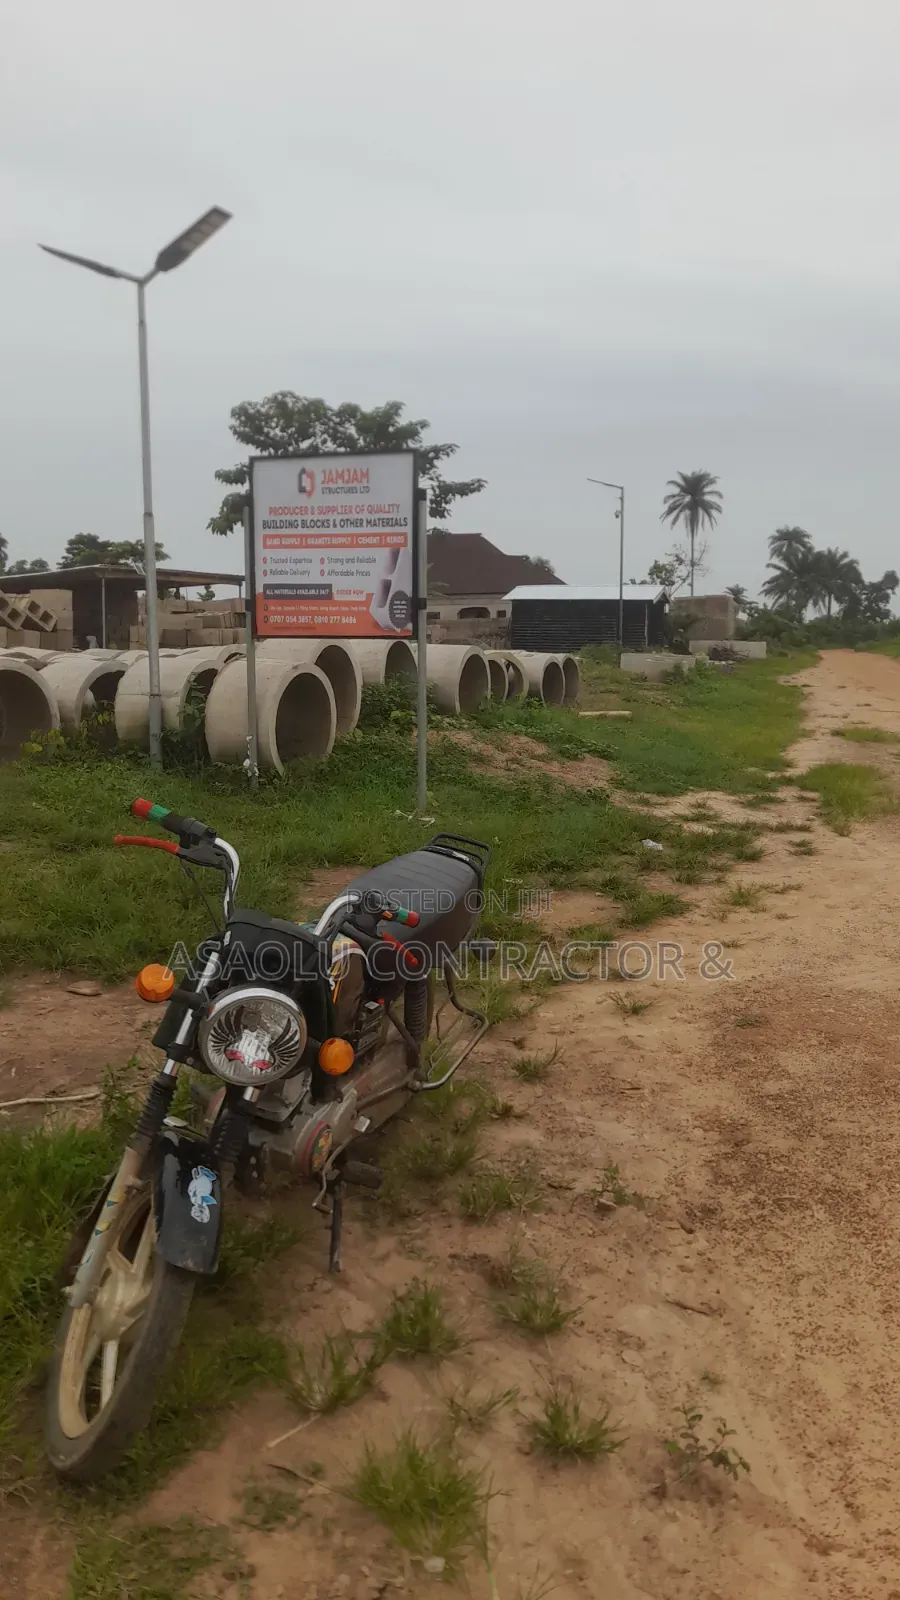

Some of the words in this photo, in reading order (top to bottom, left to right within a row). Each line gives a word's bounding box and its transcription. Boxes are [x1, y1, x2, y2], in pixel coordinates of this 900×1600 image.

[321, 468, 370, 485] JAMJAM
[321, 486, 358, 495] STRUCTURES
[359, 486, 370, 494] LTD
[269, 506, 308, 516] PRODUCER
[310, 506, 315, 515] &
[318, 505, 354, 515] SUPPLIER
[355, 505, 365, 514] OF
[367, 504, 400, 514] QUALITY
[262, 520, 299, 529] BUILDING
[301, 519, 330, 529] BLOCKS
[332, 519, 337, 528] &
[339, 518, 364, 528] OTHER
[366, 517, 408, 528] MATERIALS
[357, 536, 380, 544] CEMENT
[270, 556, 288, 564] Trusted
[289, 556, 312, 565] Expertise
[327, 556, 344, 565] Strong
[345, 556, 355, 564] and
[356, 555, 377, 564] Reliable
[269, 568, 289, 576] Reliable
[290, 568, 311, 577] Delivery
[327, 568, 354, 577] Affordable
[355, 568, 371, 577] Prices
